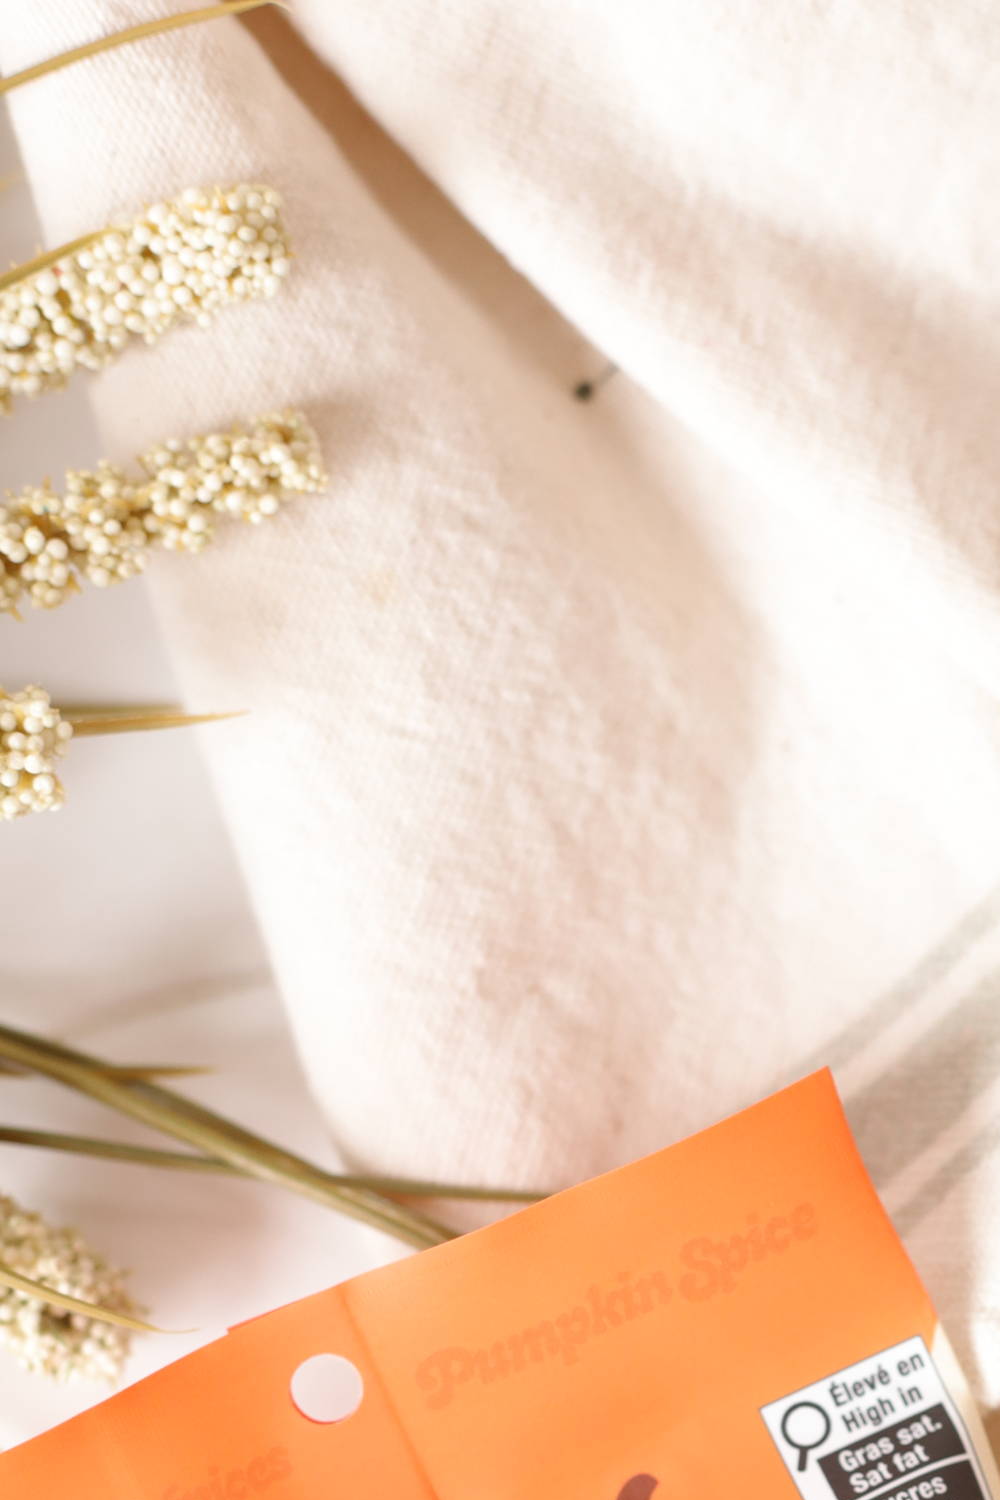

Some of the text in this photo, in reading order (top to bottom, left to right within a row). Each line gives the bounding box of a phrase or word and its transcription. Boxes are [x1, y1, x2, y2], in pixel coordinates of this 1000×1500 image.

[415, 1202, 818, 1410] Pumpkin Spice
[829, 1353, 925, 1406] Élevé en
[841, 1385, 923, 1434] High in
[838, 1413, 942, 1473] Gras sat.
[848, 1445, 930, 1494] Sat fat
